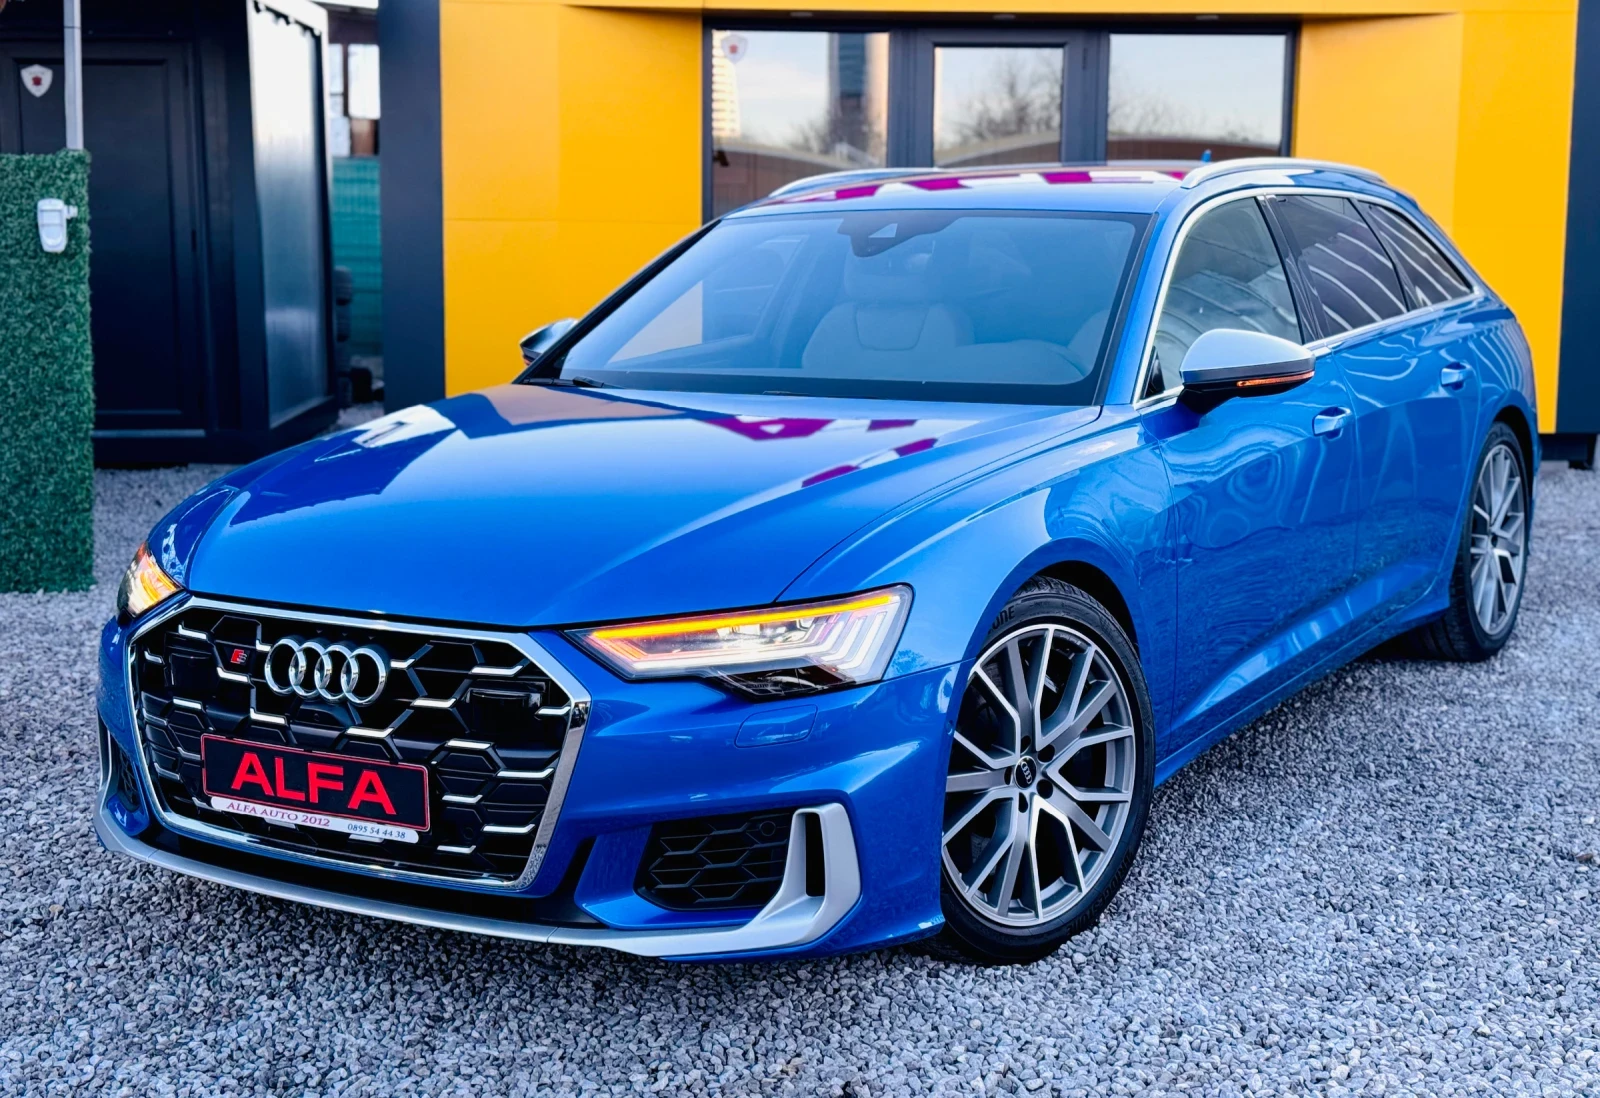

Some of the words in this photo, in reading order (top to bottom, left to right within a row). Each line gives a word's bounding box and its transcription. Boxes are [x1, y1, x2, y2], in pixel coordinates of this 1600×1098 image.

[231, 752, 397, 815] ALFA
[226, 801, 258, 815] ALFA
[260, 808, 299, 822] AUTO
[301, 814, 331, 827] 2012
[347, 822, 368, 833] 0895
[370, 826, 380, 836] 54
[382, 828, 393, 838] 44
[394, 829, 406, 839] 38
